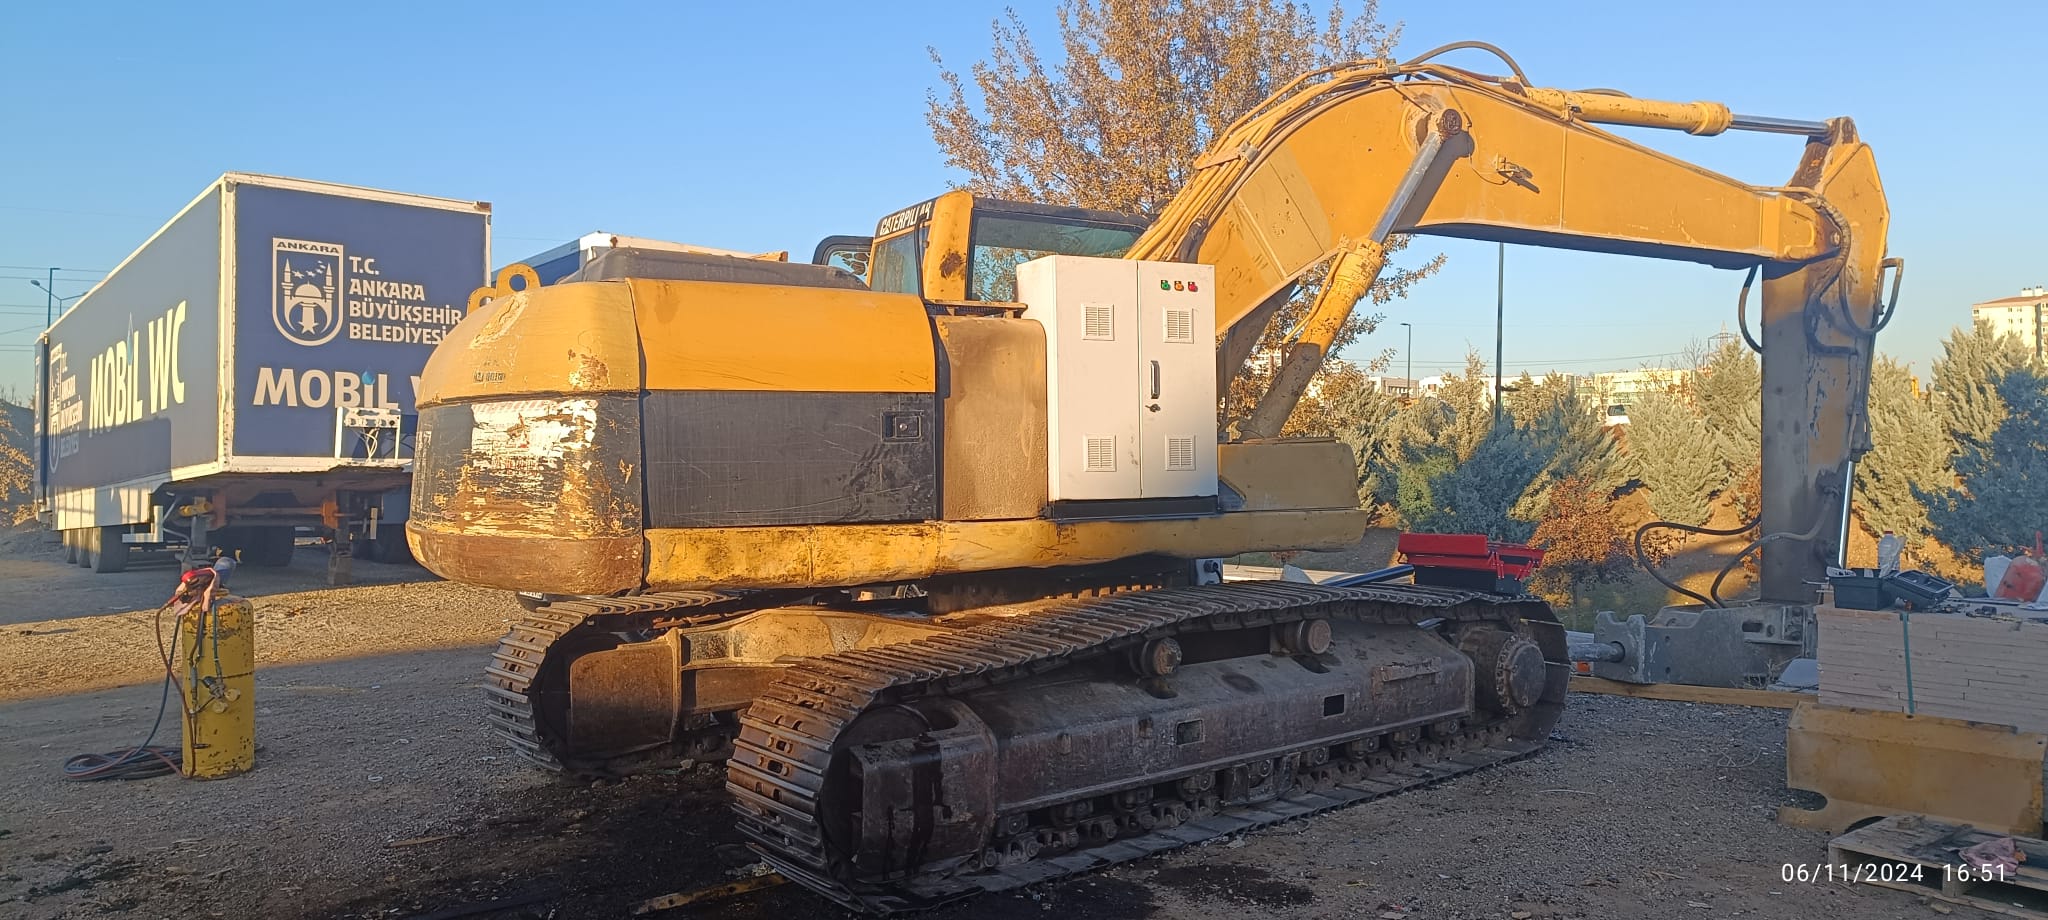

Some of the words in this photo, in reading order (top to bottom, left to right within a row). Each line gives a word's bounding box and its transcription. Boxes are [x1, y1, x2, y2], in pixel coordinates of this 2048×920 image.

[277, 241, 339, 254] ANKARA
[349, 256, 379, 275] T.C.
[349, 278, 425, 301] ANKARA
[349, 298, 462, 325] BÜYÜKŞEHİR
[148, 300, 186, 415] WC
